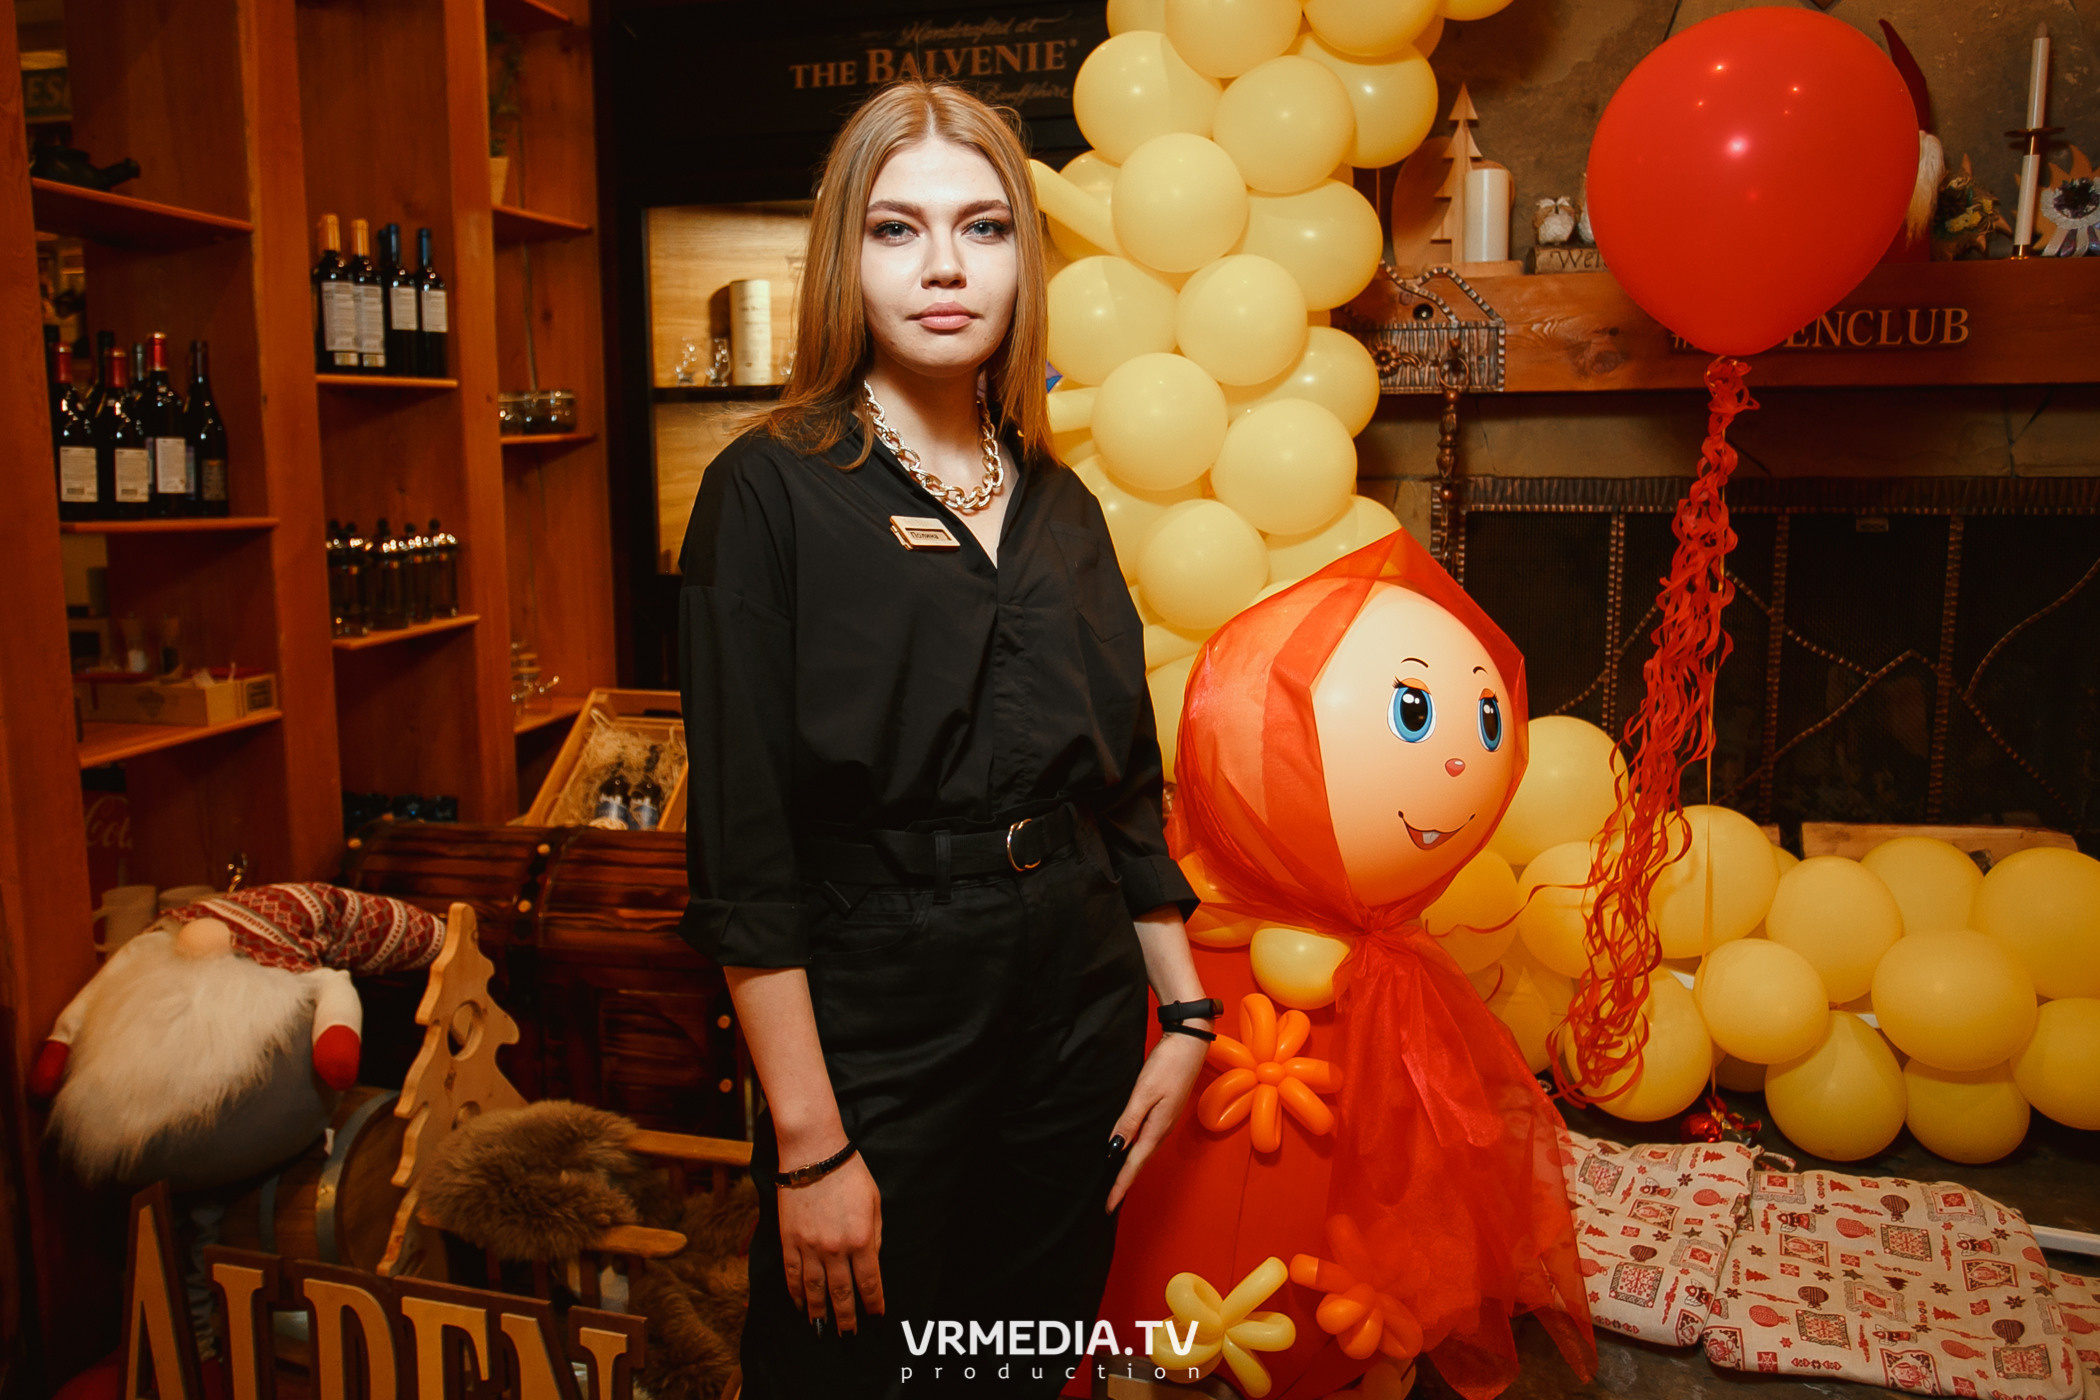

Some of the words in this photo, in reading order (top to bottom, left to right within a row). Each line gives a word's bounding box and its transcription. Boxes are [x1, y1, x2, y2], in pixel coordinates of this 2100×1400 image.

[788, 60, 858, 90] THE
[865, 40, 1067, 84] BALVENIE
[1549, 249, 1608, 269] Wel
